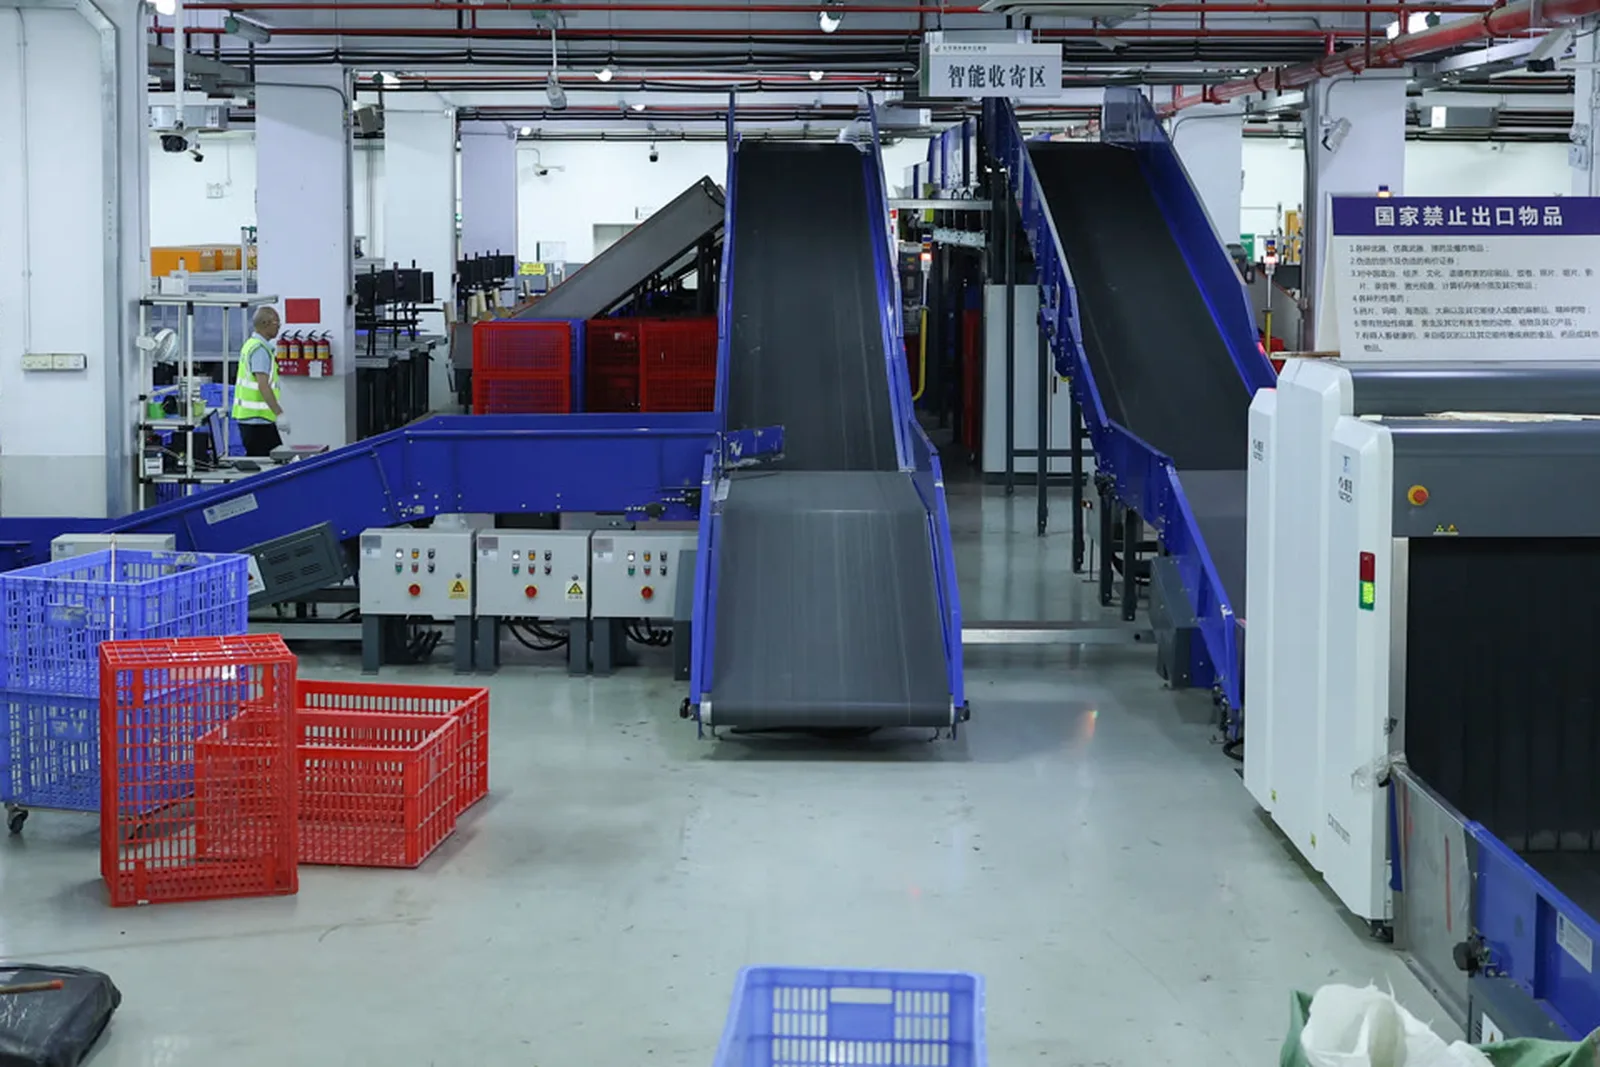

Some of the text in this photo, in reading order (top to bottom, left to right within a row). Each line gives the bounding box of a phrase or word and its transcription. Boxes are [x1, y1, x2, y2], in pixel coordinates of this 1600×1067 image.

[948, 64, 1046, 88] 智能收寄区
[1374, 206, 1564, 227] 国家禁止出口物品
